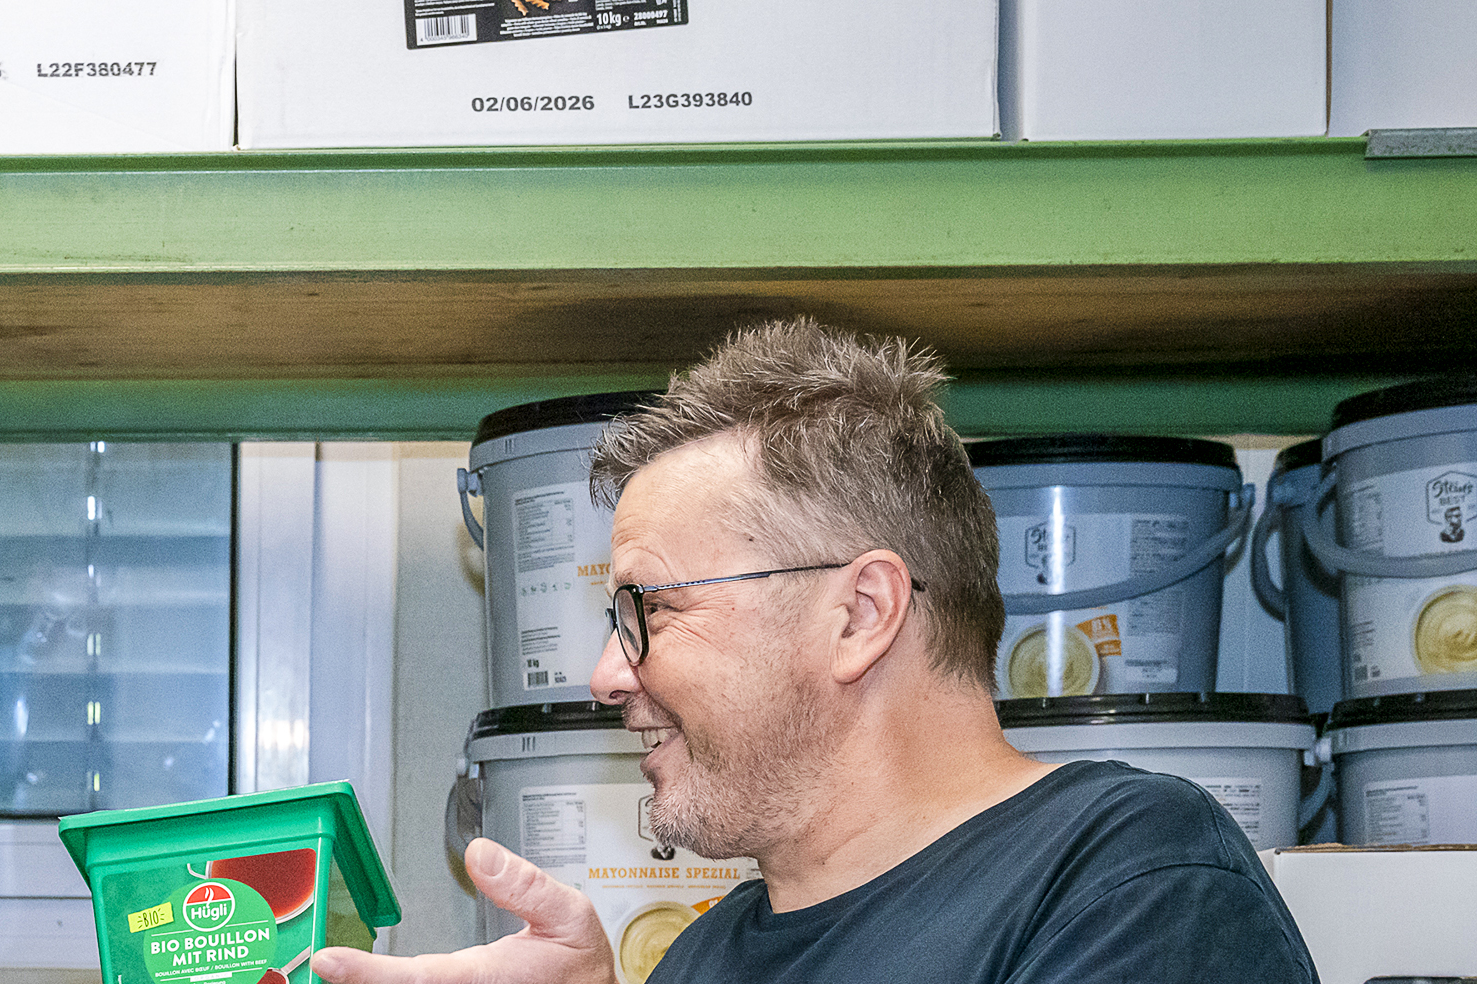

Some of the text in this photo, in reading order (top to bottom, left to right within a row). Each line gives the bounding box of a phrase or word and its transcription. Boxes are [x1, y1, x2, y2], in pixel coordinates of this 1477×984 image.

[37, 61, 157, 77] L22F380477
[471, 95, 595, 112] 02/06/2026
[628, 91, 753, 109] L23G393840
[588, 867, 741, 879] MAYONNAISE SPEZIAL
[143, 910, 158, 927] BIO
[191, 903, 227, 921] Hügli
[151, 928, 270, 954] BIO BOUILLON
[172, 946, 249, 966] MIT RIND
[155, 969, 180, 978] BOUILLON
[215, 962, 240, 971] BOUILLON
